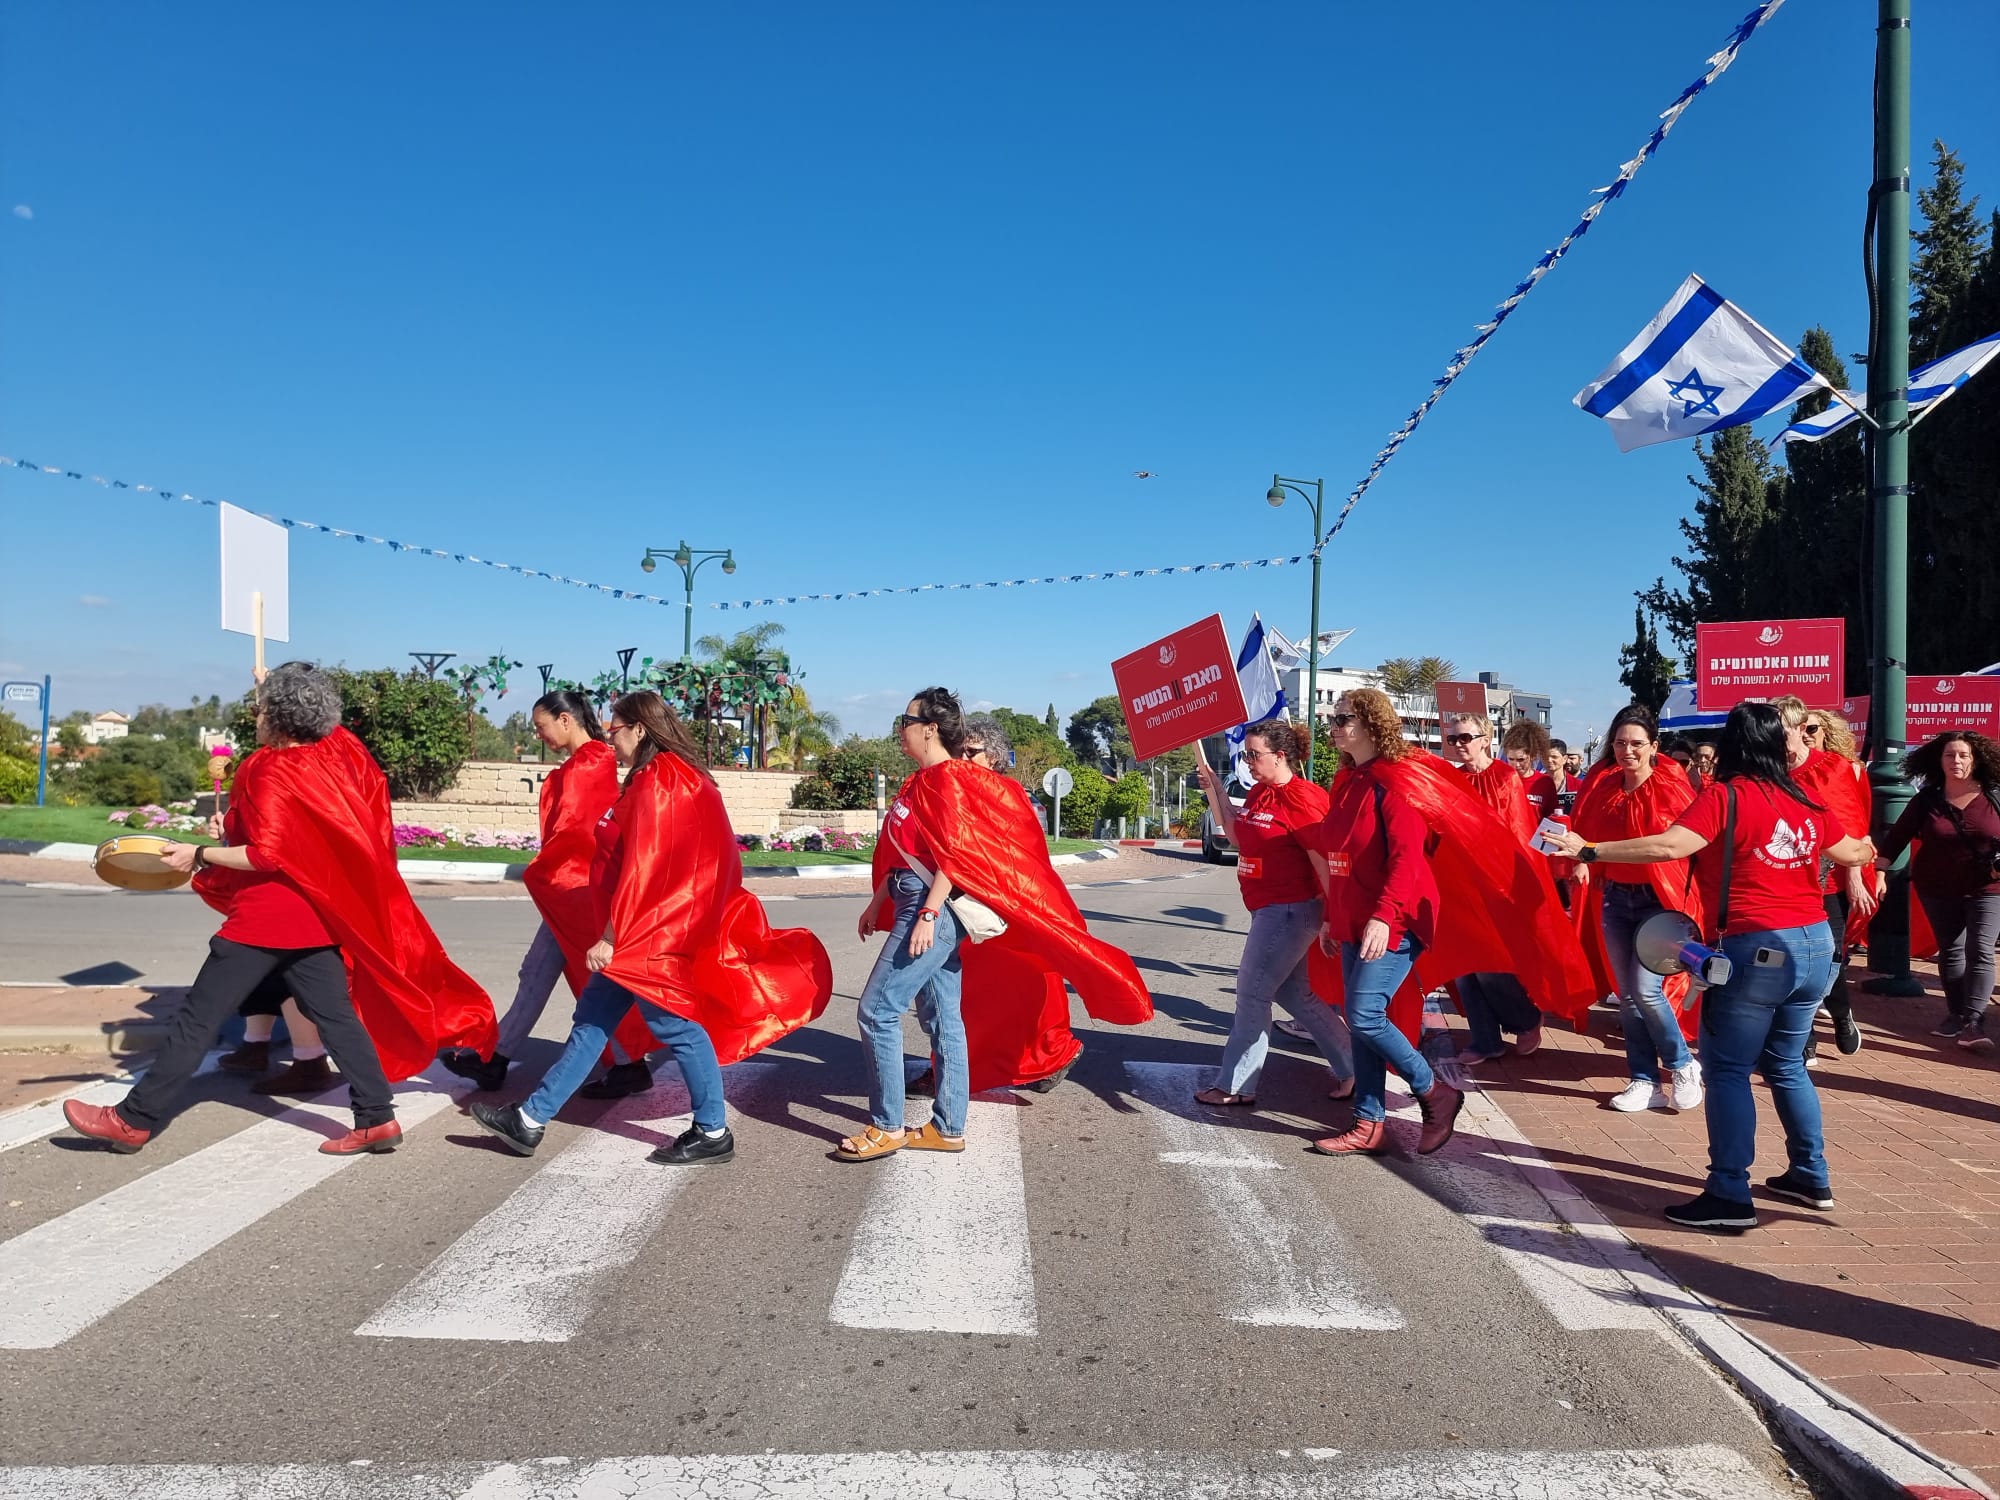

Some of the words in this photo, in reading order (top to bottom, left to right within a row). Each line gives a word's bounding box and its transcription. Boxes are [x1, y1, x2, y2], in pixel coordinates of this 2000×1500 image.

[1710, 656, 1789, 670] האלטרנטיבה
[1793, 655, 1830, 668] אנחנו
[1182, 664, 1222, 695] מאבק
[1711, 676, 1731, 686] שלנו
[1733, 675, 1770, 685] במשמרת
[1773, 674, 1785, 684] לא
[1787, 673, 1830, 684] דיקטטורה
[1132, 685, 1173, 714] הנשים
[1208, 691, 1218, 704] לא
[1905, 702, 1960, 713] האלטרנטי
[1962, 703, 1993, 713] אנחנו
[1145, 715, 1161, 729] שלנו
[1905, 717, 1935, 726] דמוקרטי
[1936, 717, 1947, 726] אין
[1976, 717, 1987, 726] אין
